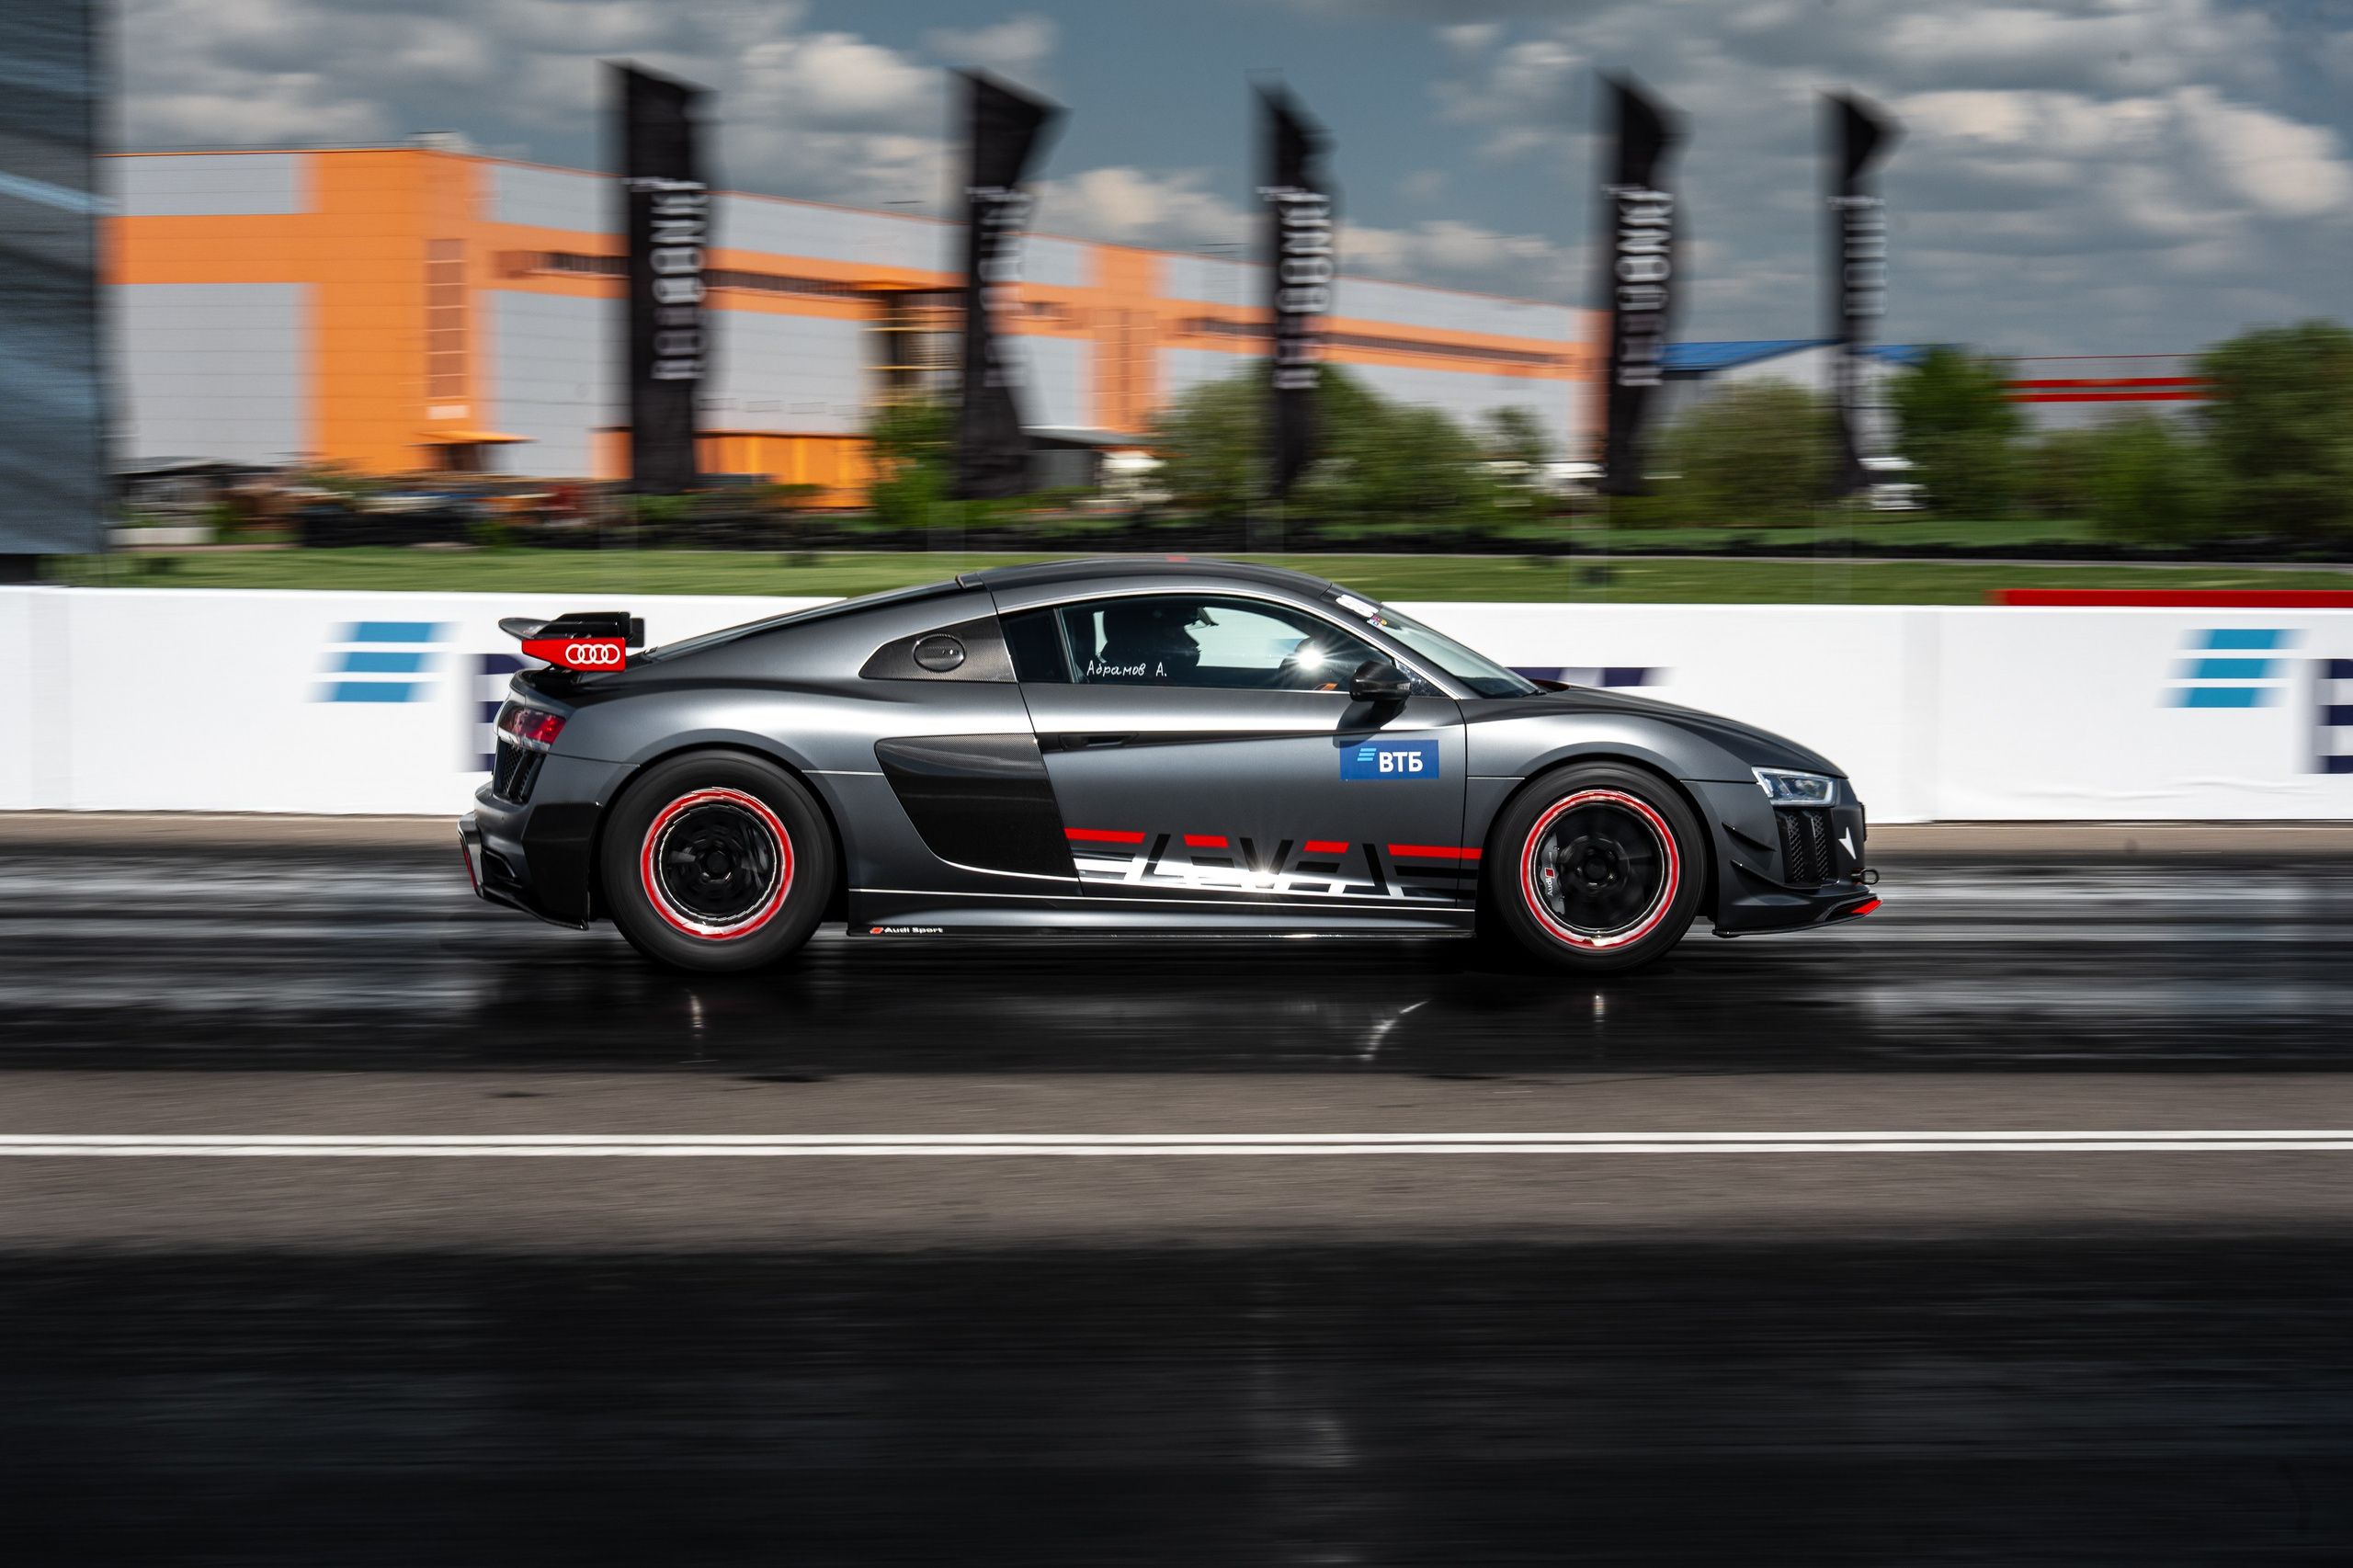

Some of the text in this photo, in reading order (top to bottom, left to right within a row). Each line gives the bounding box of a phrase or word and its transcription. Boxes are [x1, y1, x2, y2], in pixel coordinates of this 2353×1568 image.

[1086, 660, 1167, 677] Абрамов А.
[1379, 751, 1424, 773] ВТБ
[1545, 878, 1554, 897] Audi
[884, 923, 943, 934] Audi Sport
